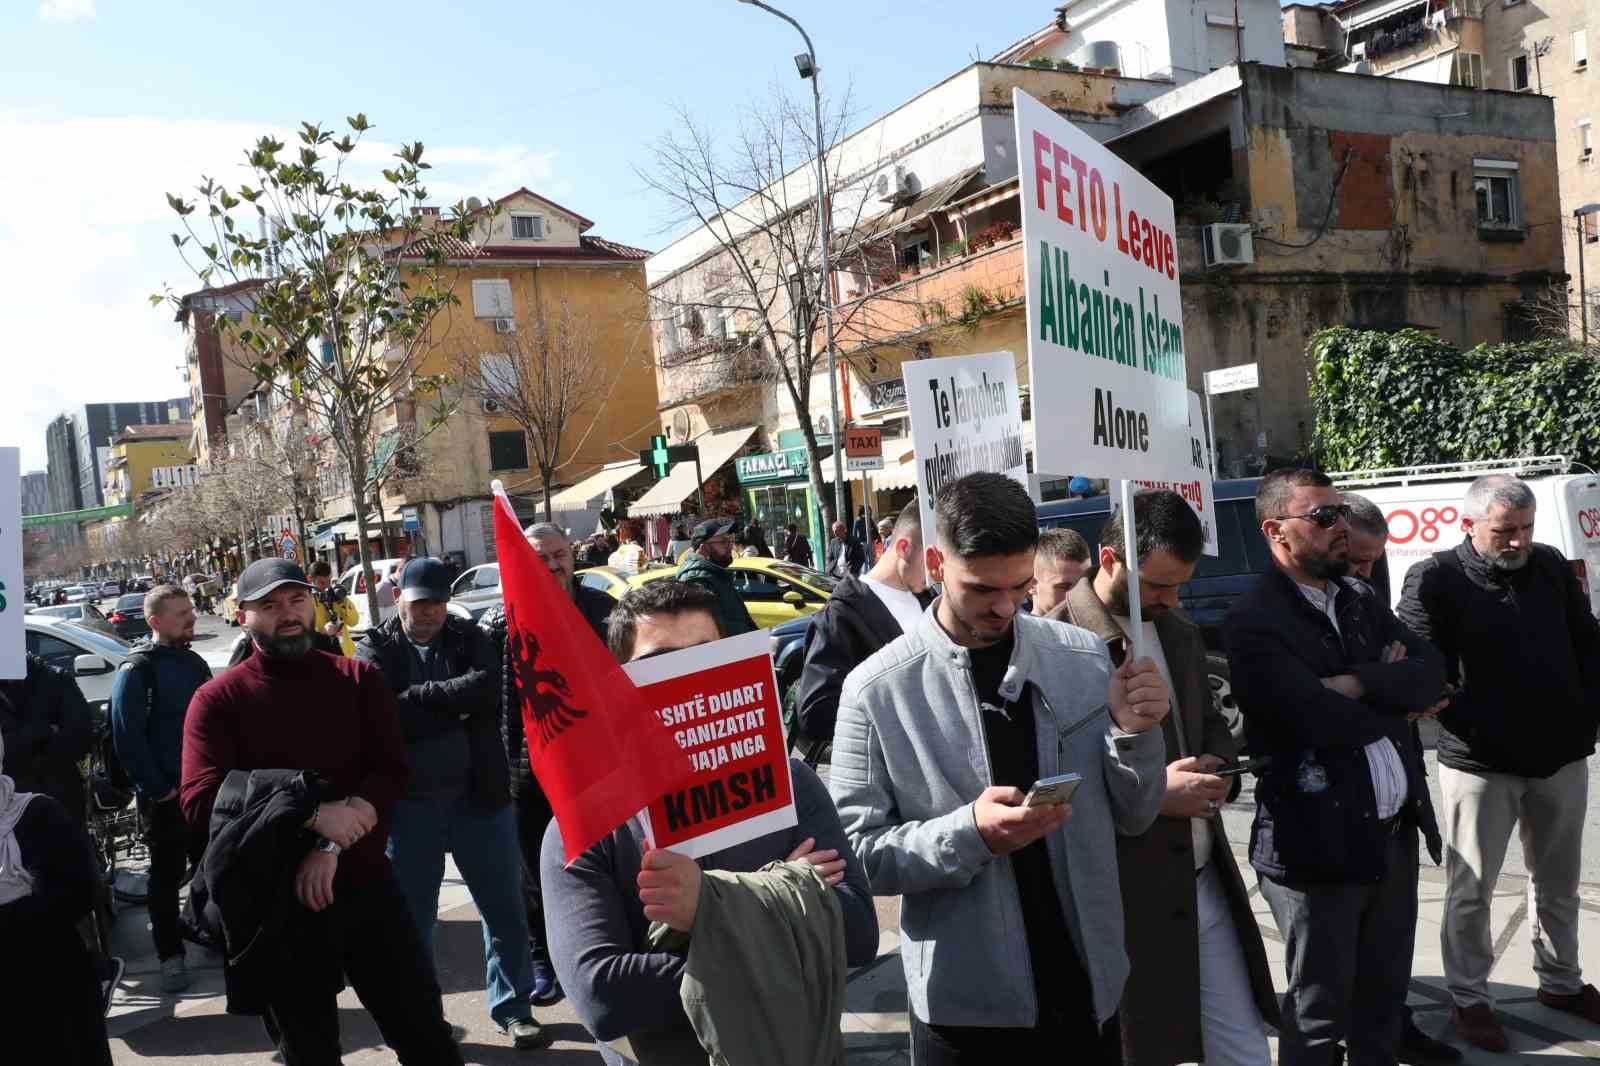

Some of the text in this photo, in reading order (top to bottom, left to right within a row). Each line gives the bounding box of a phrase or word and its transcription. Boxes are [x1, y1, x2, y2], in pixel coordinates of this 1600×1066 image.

[1033, 129, 1175, 280] FETO Leave
[1040, 240, 1184, 381] Albanian Islam
[929, 371, 1007, 433] Te largohen
[1093, 387, 1149, 452] Alone
[850, 436, 878, 449] TAXI
[708, 682, 764, 714] DUART
[731, 734, 766, 761] NGA
[663, 763, 776, 832] KMSH
